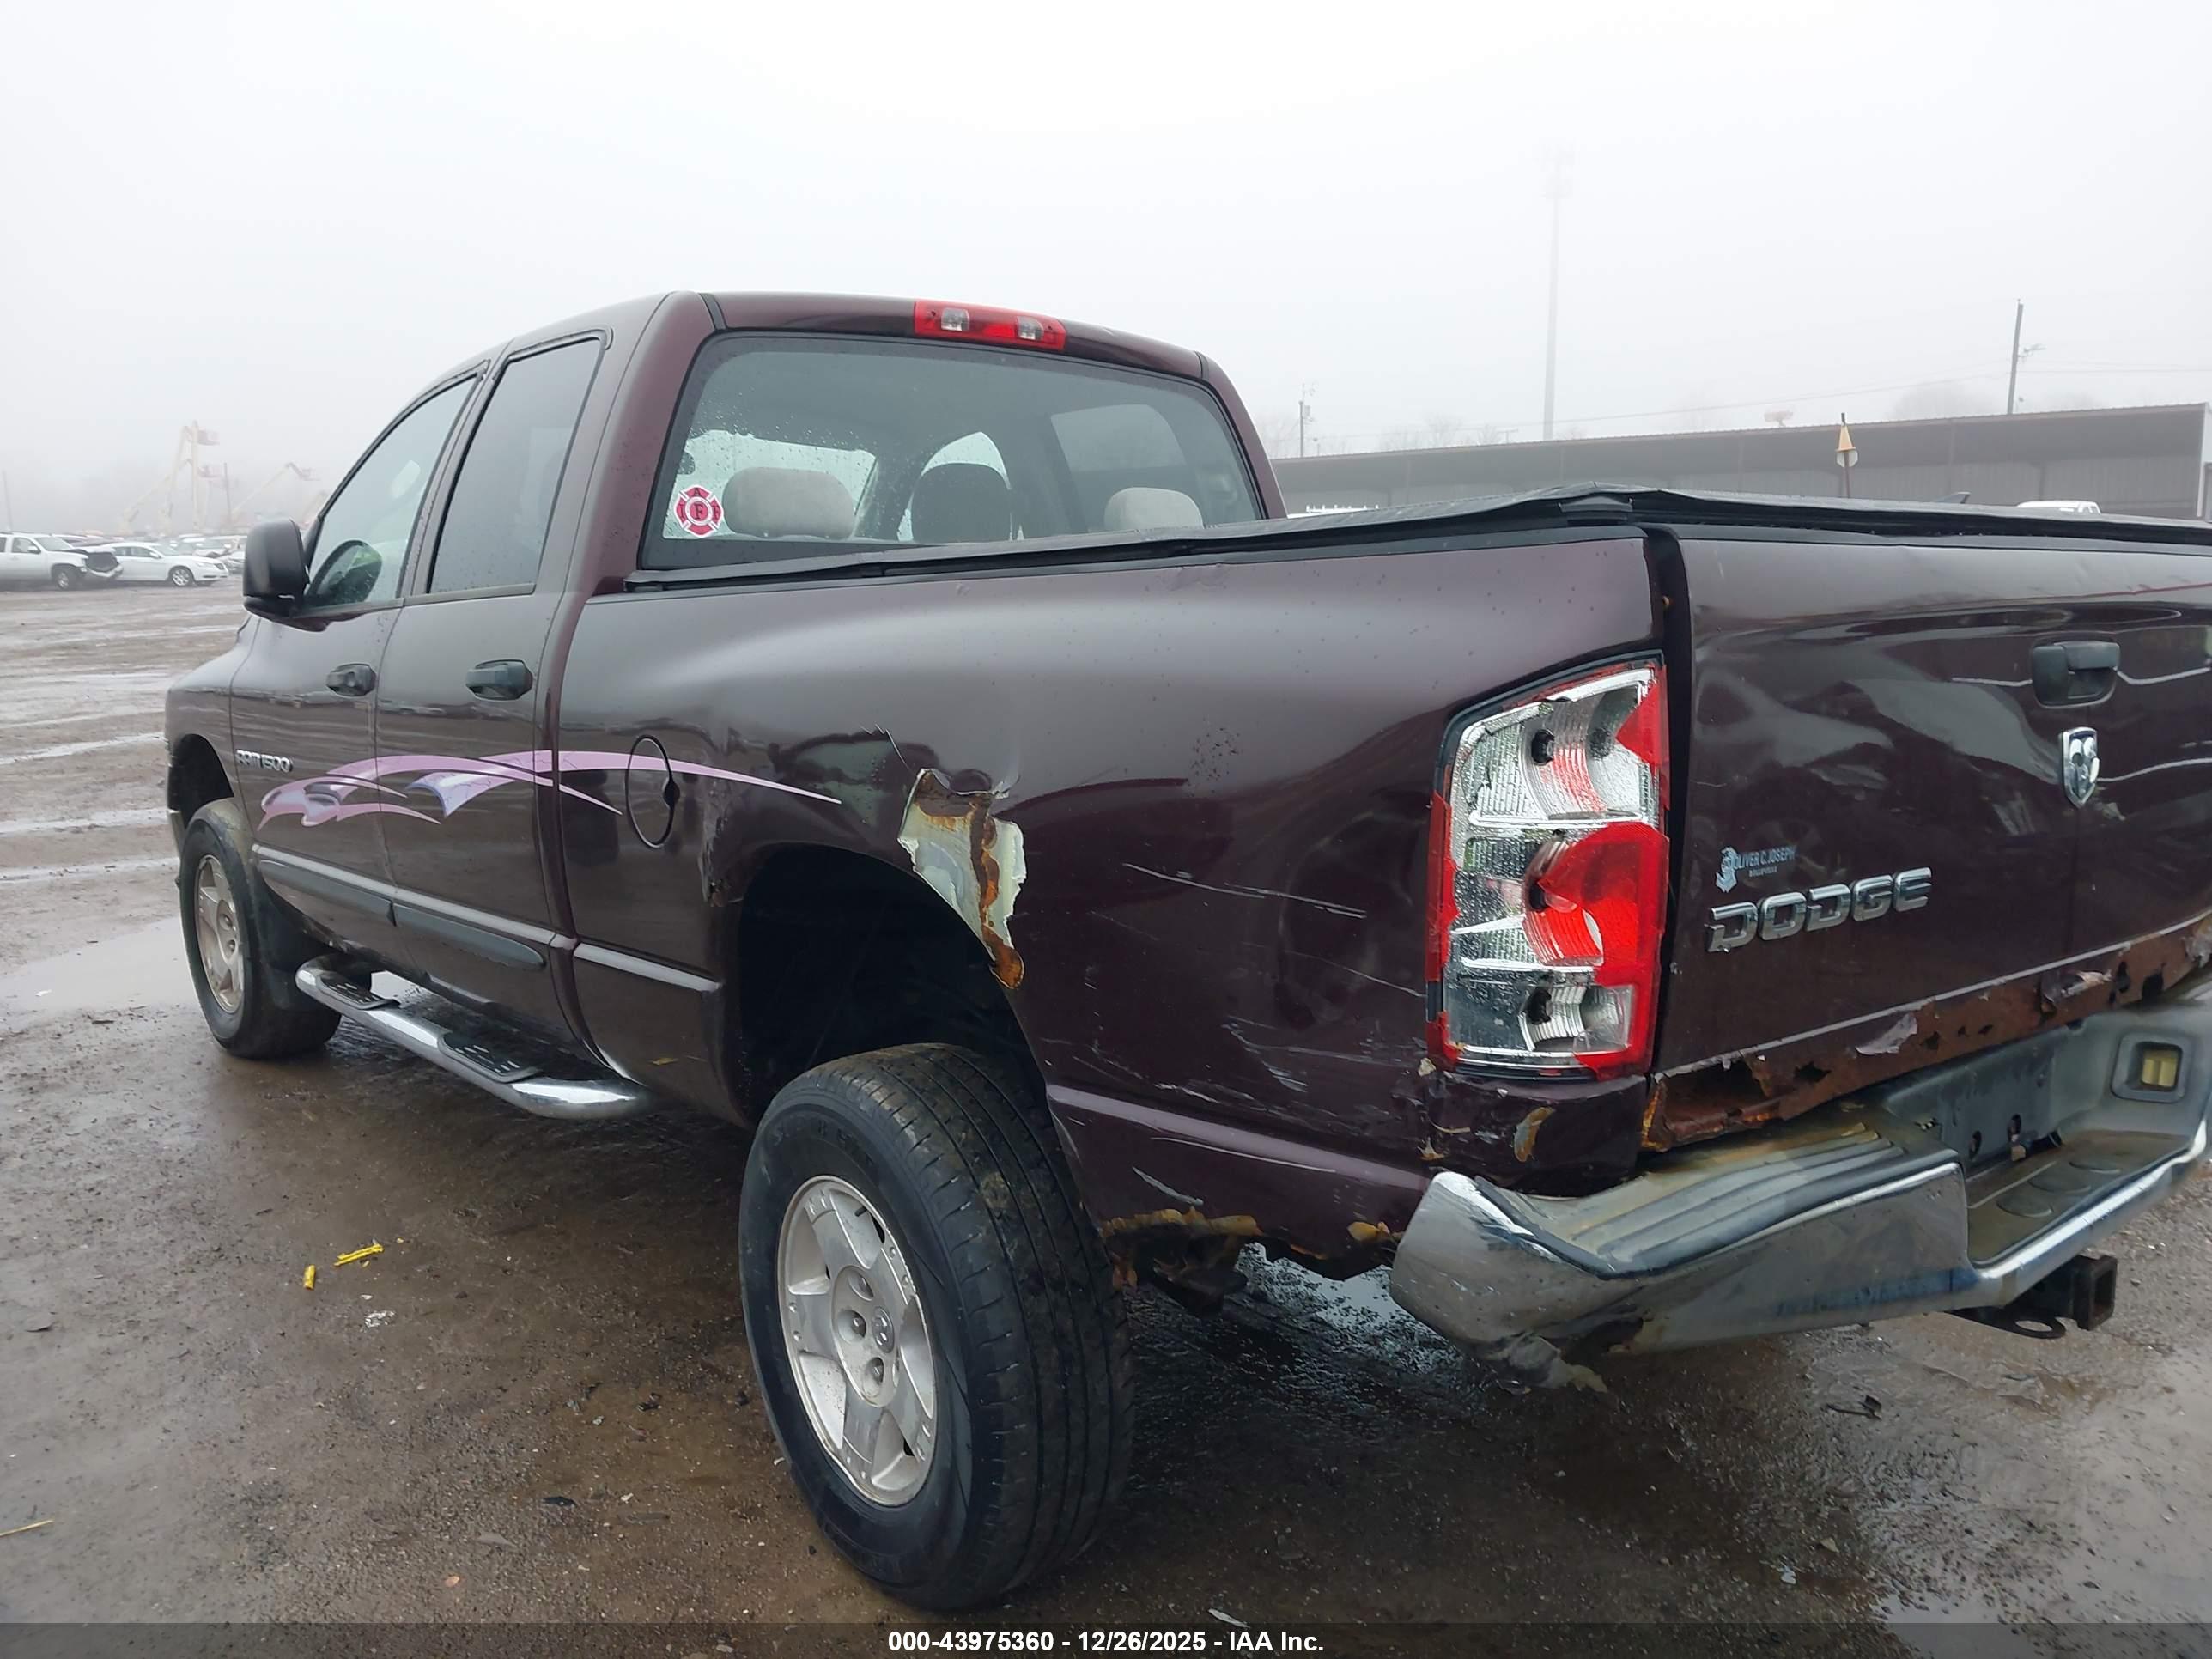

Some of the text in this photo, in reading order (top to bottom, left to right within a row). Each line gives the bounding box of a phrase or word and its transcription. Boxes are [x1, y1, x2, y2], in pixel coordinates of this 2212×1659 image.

[692, 487, 702, 498] A
[694, 503, 703, 520] F
[259, 754, 292, 773] 1500
[1705, 866, 1932, 952] DODGE
